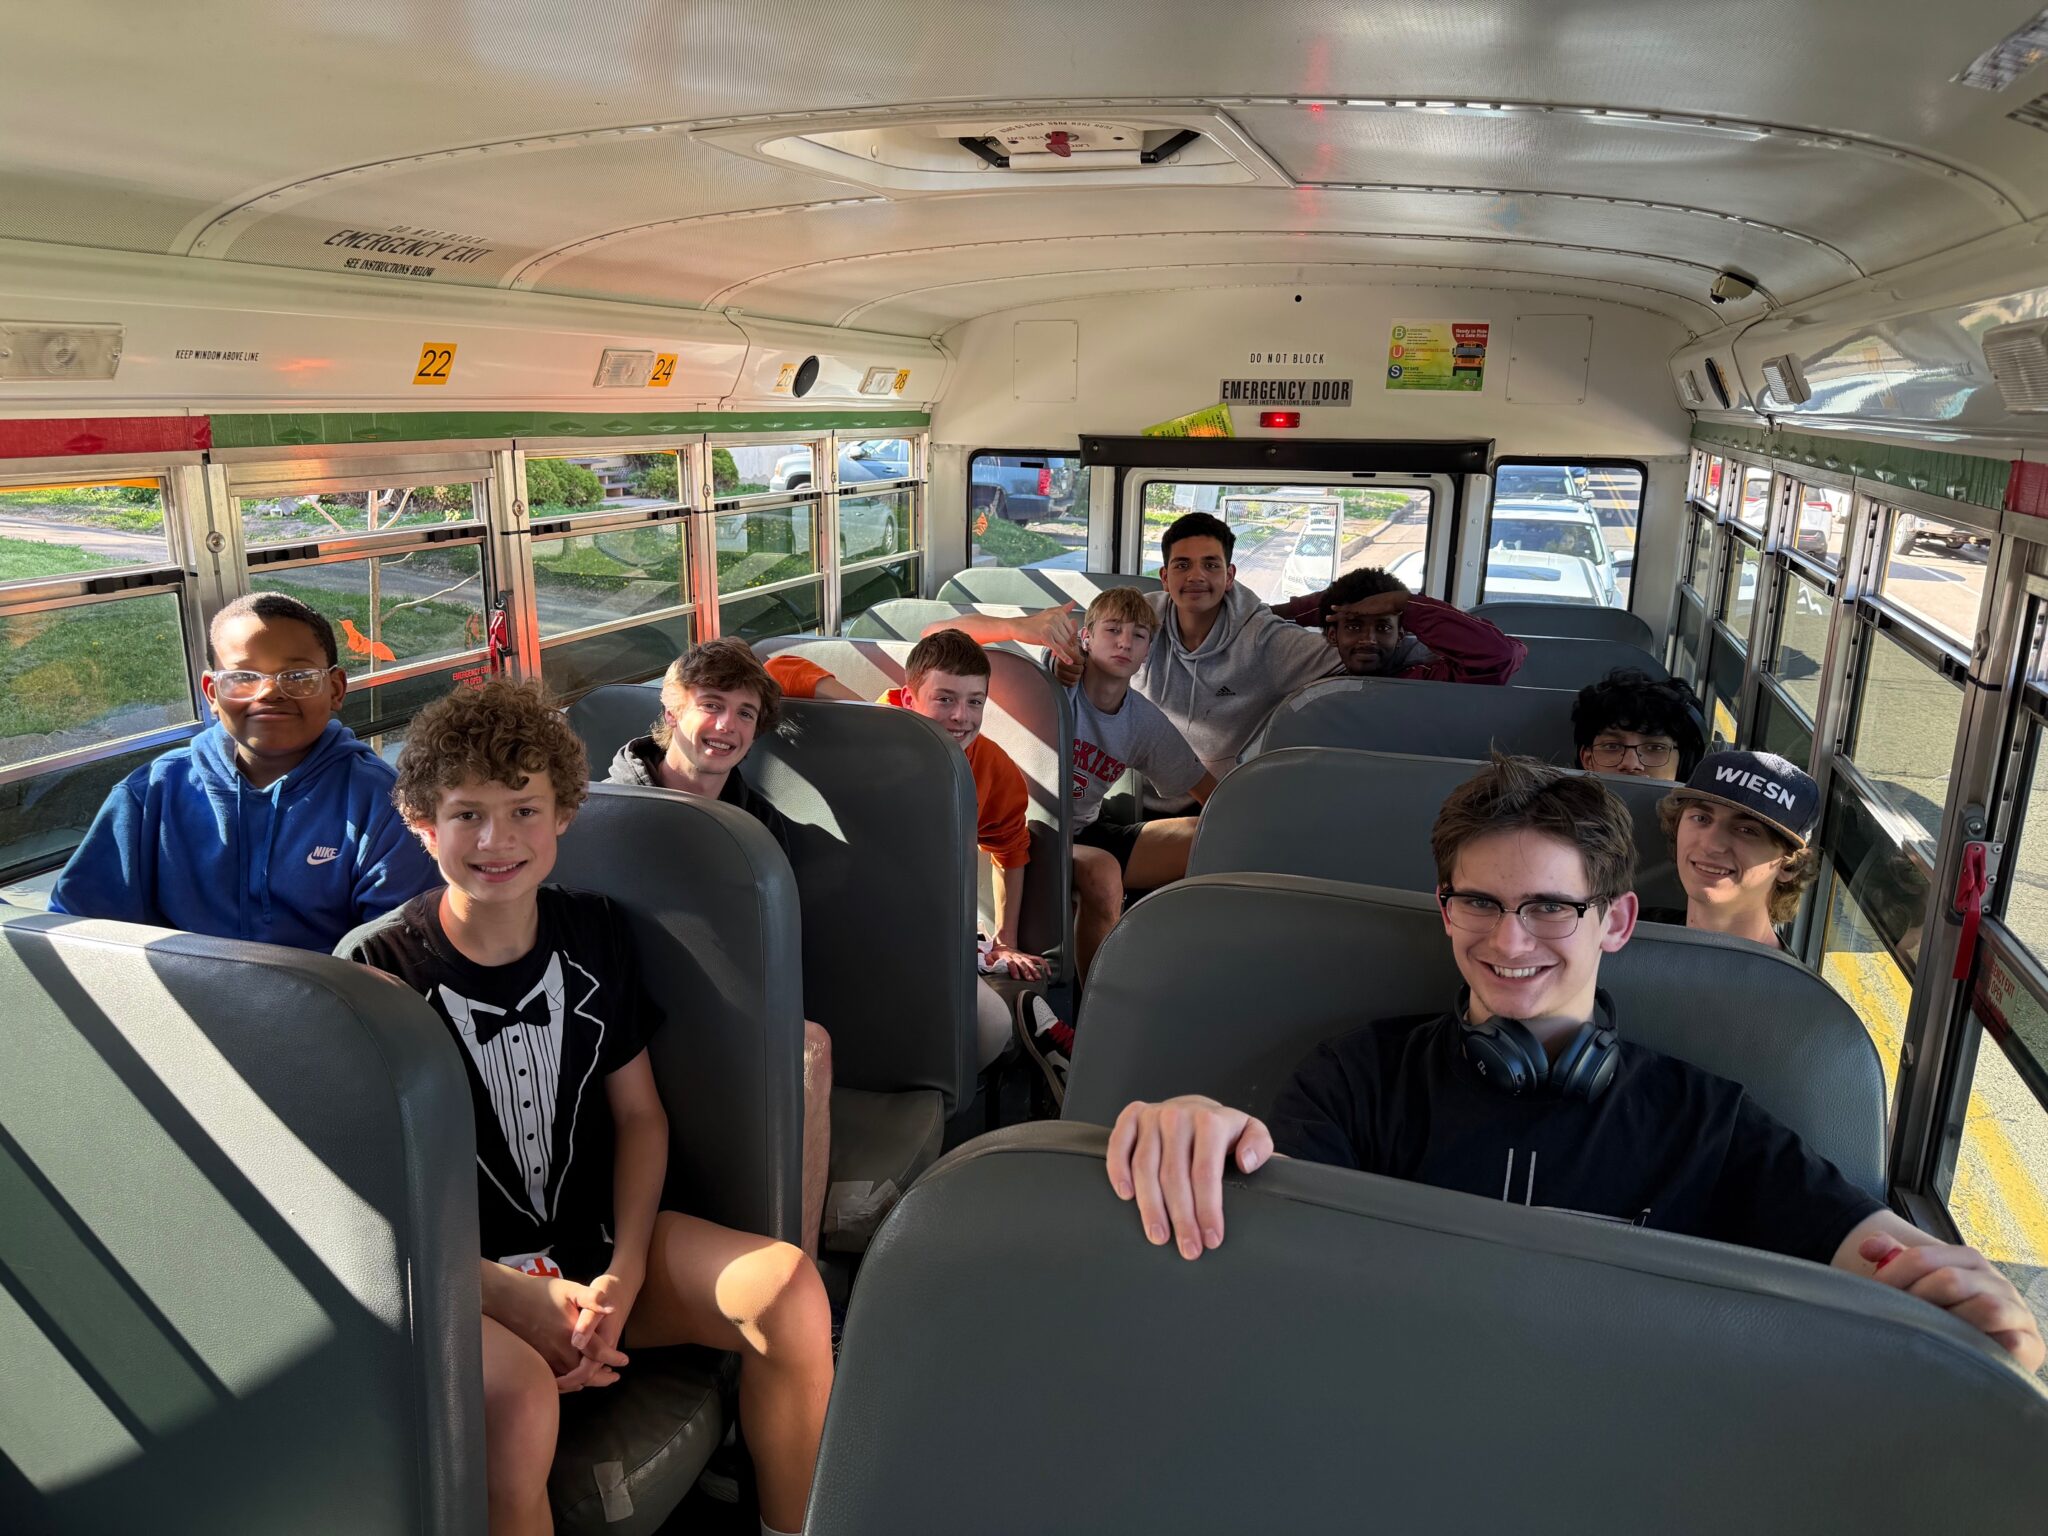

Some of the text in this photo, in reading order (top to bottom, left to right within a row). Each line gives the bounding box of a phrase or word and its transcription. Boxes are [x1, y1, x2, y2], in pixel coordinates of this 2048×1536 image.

[387, 225, 488, 244] DO NOT BLOCK
[323, 229, 494, 263] EMERGENCY EXIT
[344, 257, 436, 277] SEE INSTRUCTIONS BELOW
[176, 350, 259, 361] KEEP WINDOW ABOVE LINE
[418, 350, 451, 377] 22
[1250, 353, 1324, 364] DO NOT BLOCK
[652, 359, 674, 381] 24
[776, 368, 794, 387] 26
[894, 373, 907, 389] 28
[1222, 381, 1350, 400] EMERGENCY DOOR
[1073, 738, 1126, 783] SKIES
[1715, 766, 1796, 811] WIESN
[313, 846, 338, 859] NIKE
